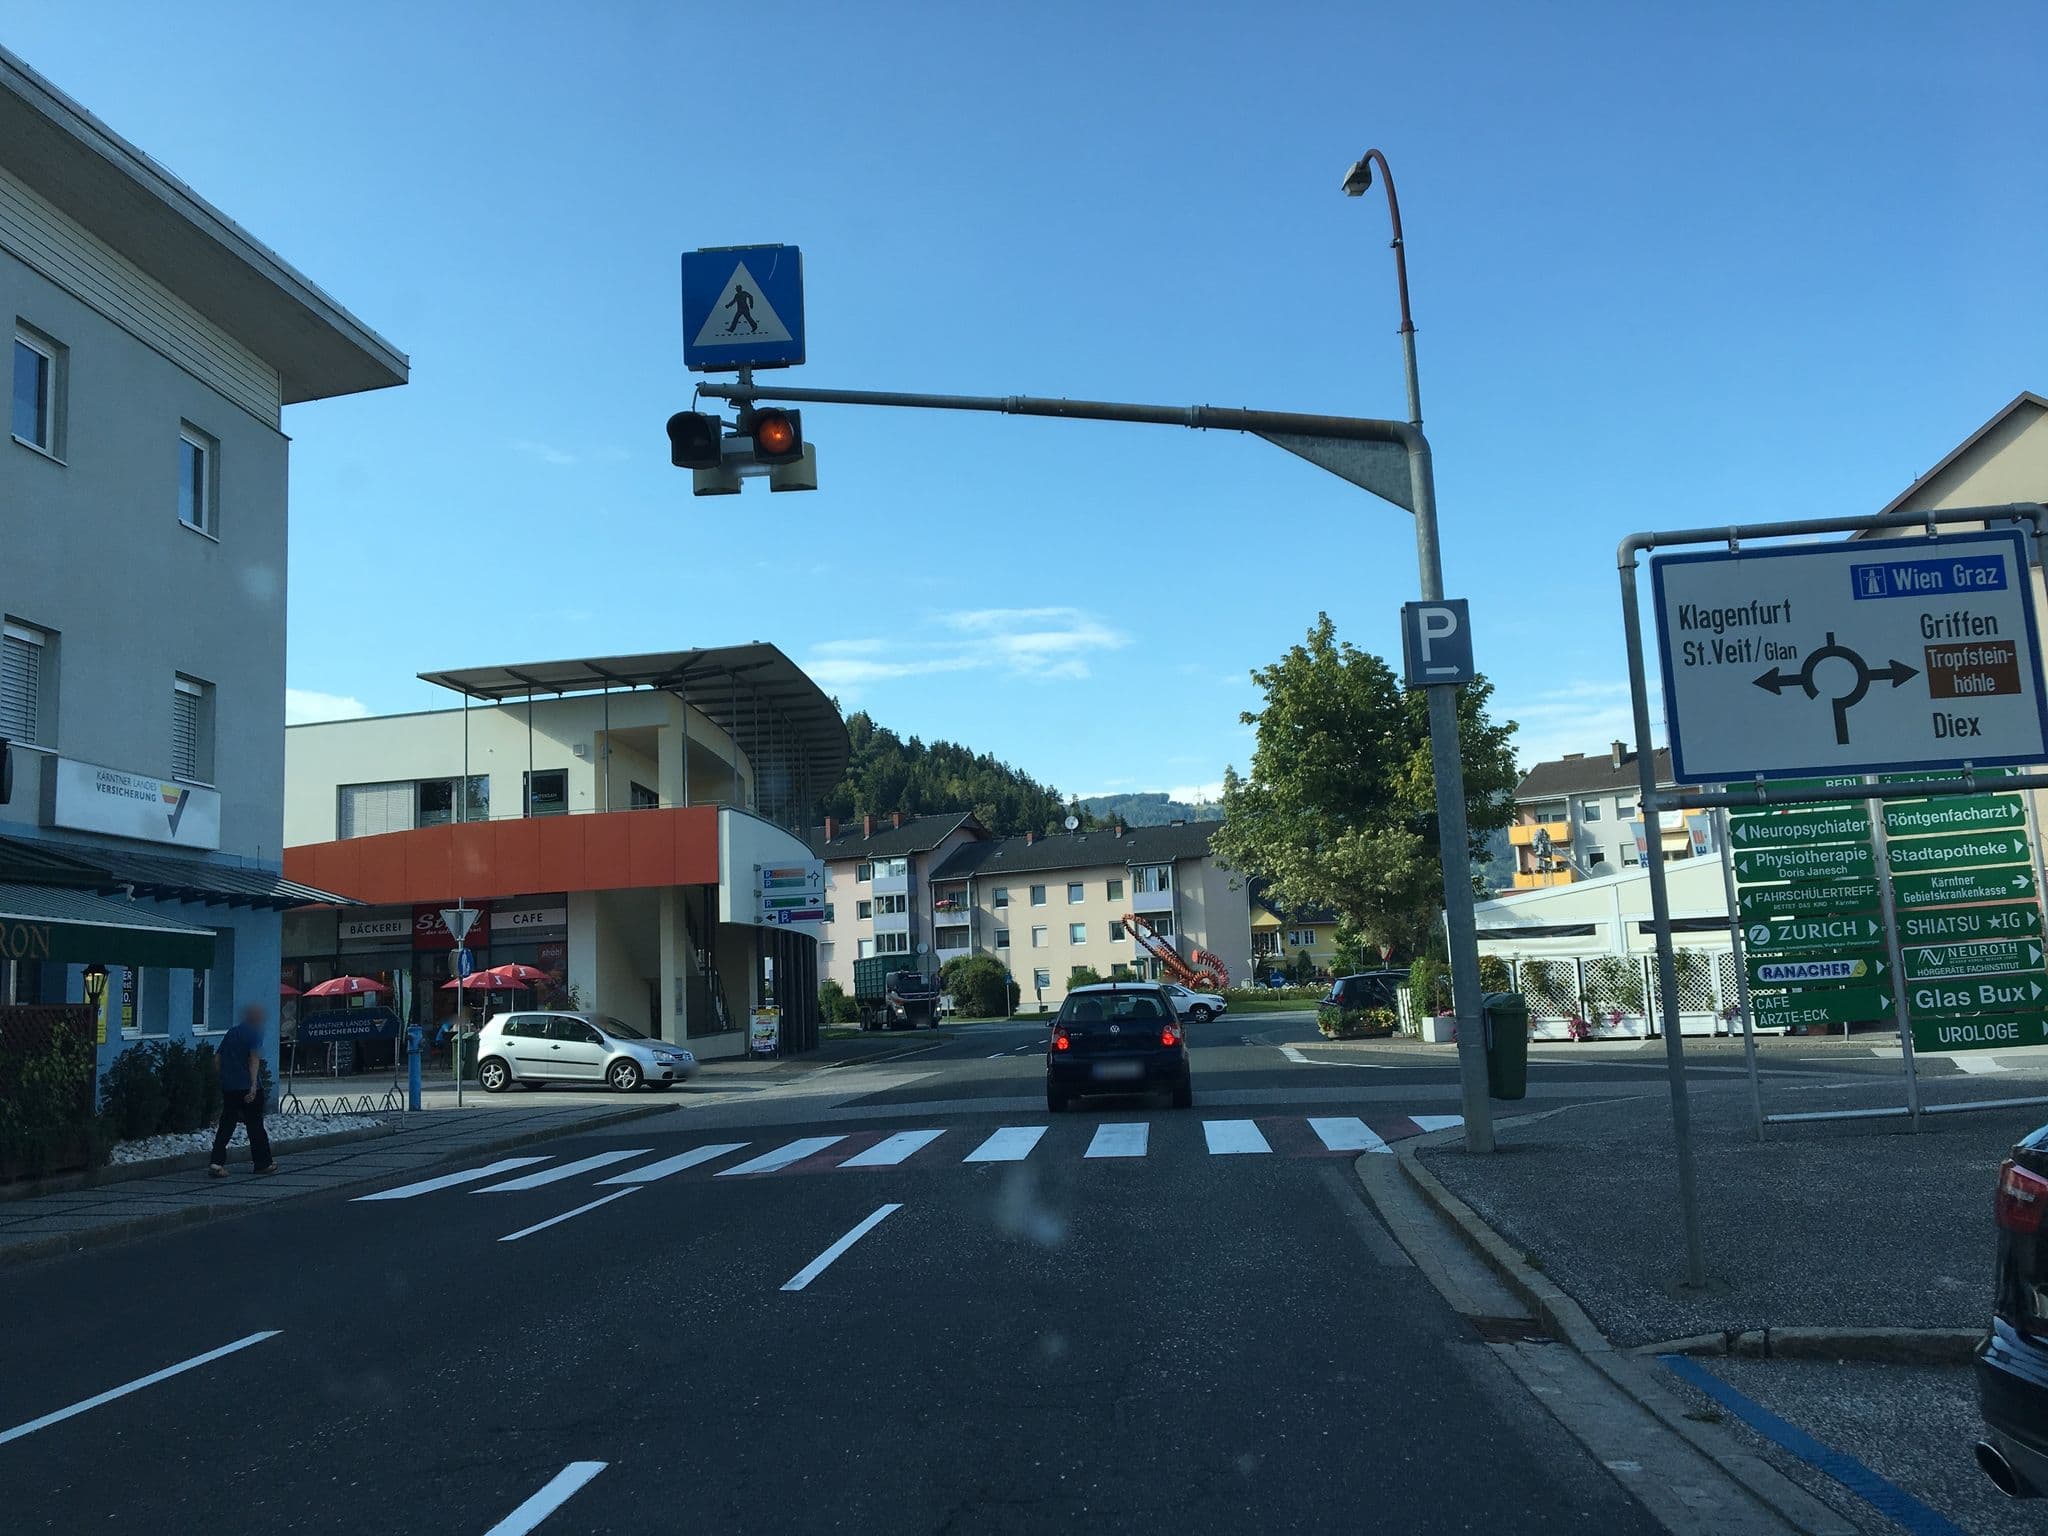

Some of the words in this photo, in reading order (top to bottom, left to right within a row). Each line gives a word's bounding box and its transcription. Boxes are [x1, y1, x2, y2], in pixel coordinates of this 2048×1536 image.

[1892, 568, 1942, 591] Wien
[1953, 563, 1998, 588] Graz
[1678, 599, 1791, 634] Klagenfurt
[1920, 611, 1998, 640] Griffen
[1418, 607, 1457, 662] P
[1927, 648, 2014, 670] Tropfstein-
[1953, 673, 1996, 694] höhle
[1932, 712, 1982, 739] Diex
[96, 782, 157, 802] VERSICHERUNG
[1888, 804, 2008, 827] Röntgenfacharzt
[1750, 819, 1866, 839] Neuropsychiater
[1755, 847, 1867, 868] Physiotherapie
[1892, 842, 2008, 862] Stadtapotheke
[1779, 868, 1805, 878] Doris
[1807, 865, 1848, 876] Janesch
[1931, 876, 1975, 889] Kärntner
[1755, 885, 1874, 903] FAHRSCHÜLERTREFF
[1903, 886, 2007, 904] Gebietskrankenkasse
[350, 922, 402, 935] BÄCKEREI
[513, 913, 543, 924] CAFE
[1907, 915, 1980, 935] SHIATSU
[2001, 912, 2021, 929] IG
[1777, 920, 1858, 941] ZURICH
[1948, 942, 2018, 957] NEUROTH
[1762, 963, 1850, 980] RANACHER
[1917, 965, 1965, 976] HÖRGERÄTE
[1967, 962, 2020, 973] FACHINSTITUT
[1756, 996, 1790, 1010] CAFE
[1915, 988, 1971, 1009] Glas
[1979, 984, 2026, 1004] Bux
[1759, 1008, 1829, 1026] ÄRZTE-ECK
[308, 1027, 370, 1037] VERSICHERUNG
[1938, 1022, 2020, 1043] UROLOGE
